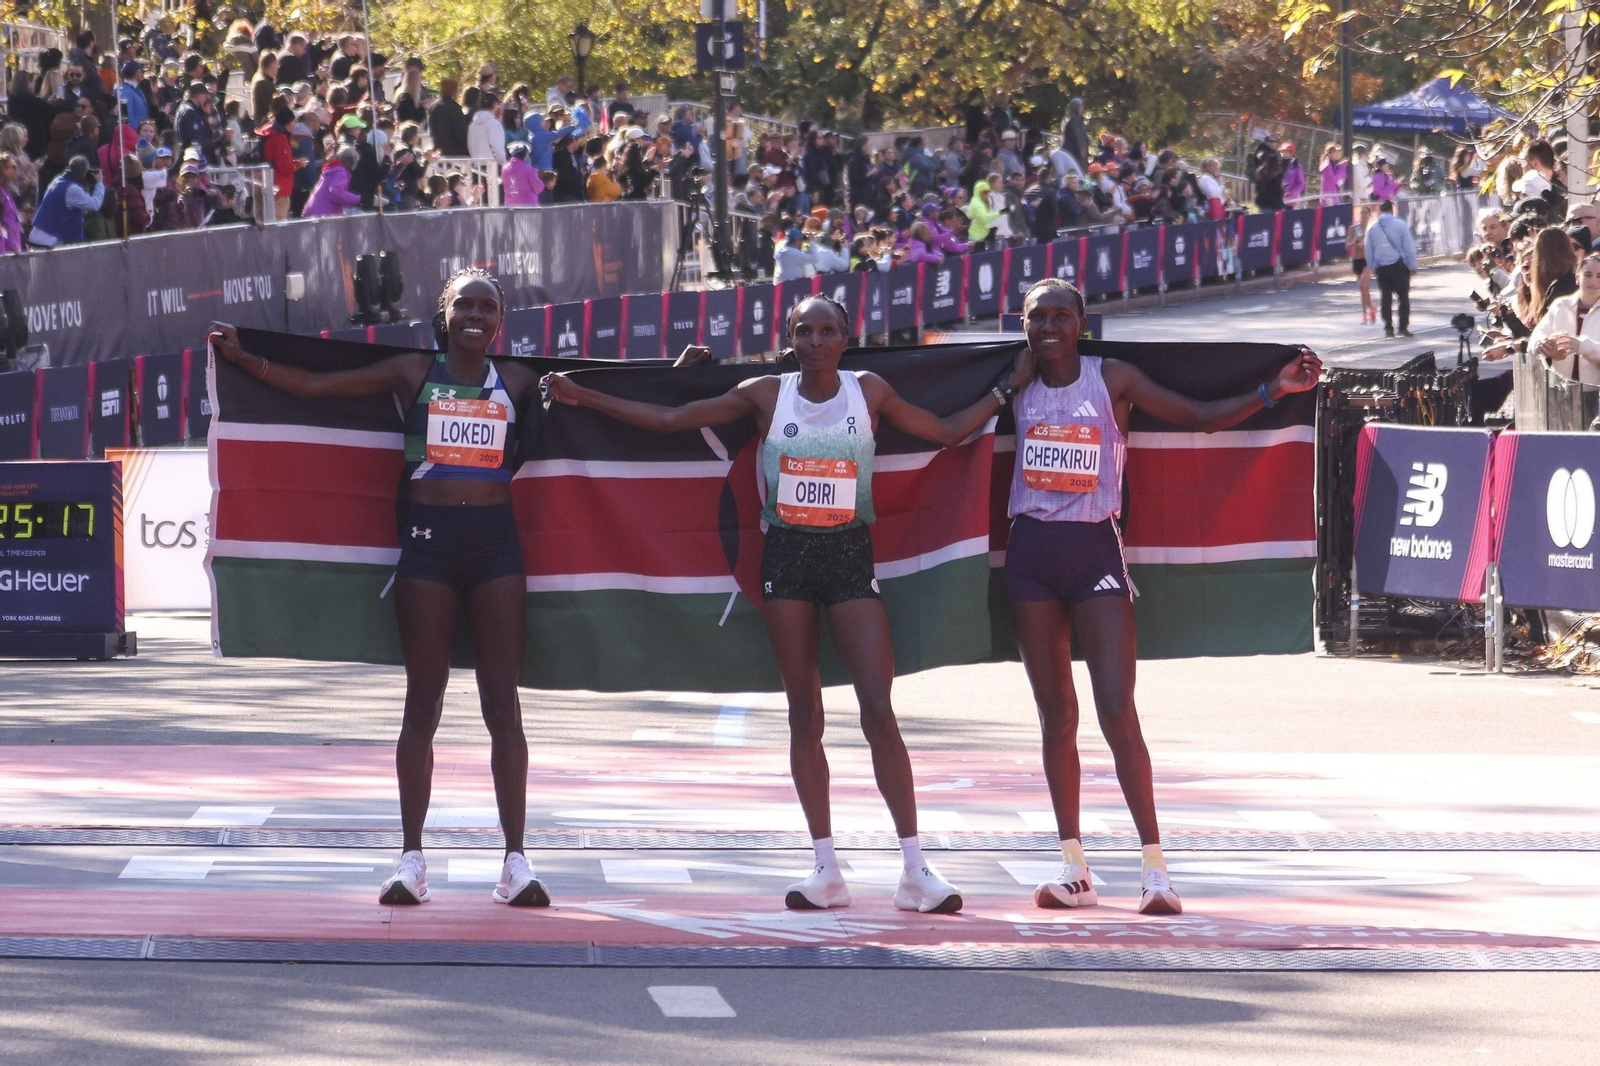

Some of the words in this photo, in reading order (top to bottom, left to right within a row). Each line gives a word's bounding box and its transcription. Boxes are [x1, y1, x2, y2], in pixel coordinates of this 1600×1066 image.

[148, 290, 158, 316] IT
[161, 287, 186, 314] WILL
[223, 277, 253, 305] MOVE
[253, 275, 272, 300] YOU
[60, 300, 82, 328] YOU
[440, 420, 495, 446] LOKEDI
[480, 454, 499, 462] 2025
[1025, 445, 1097, 472] CHEPKIRUI
[795, 481, 836, 505] OBIRI
[1070, 478, 1093, 487] 2025
[140, 513, 197, 549] tcs
[1390, 537, 1411, 556] new
[1411, 535, 1452, 560] balance
[1548, 552, 1594, 570] mastercard
